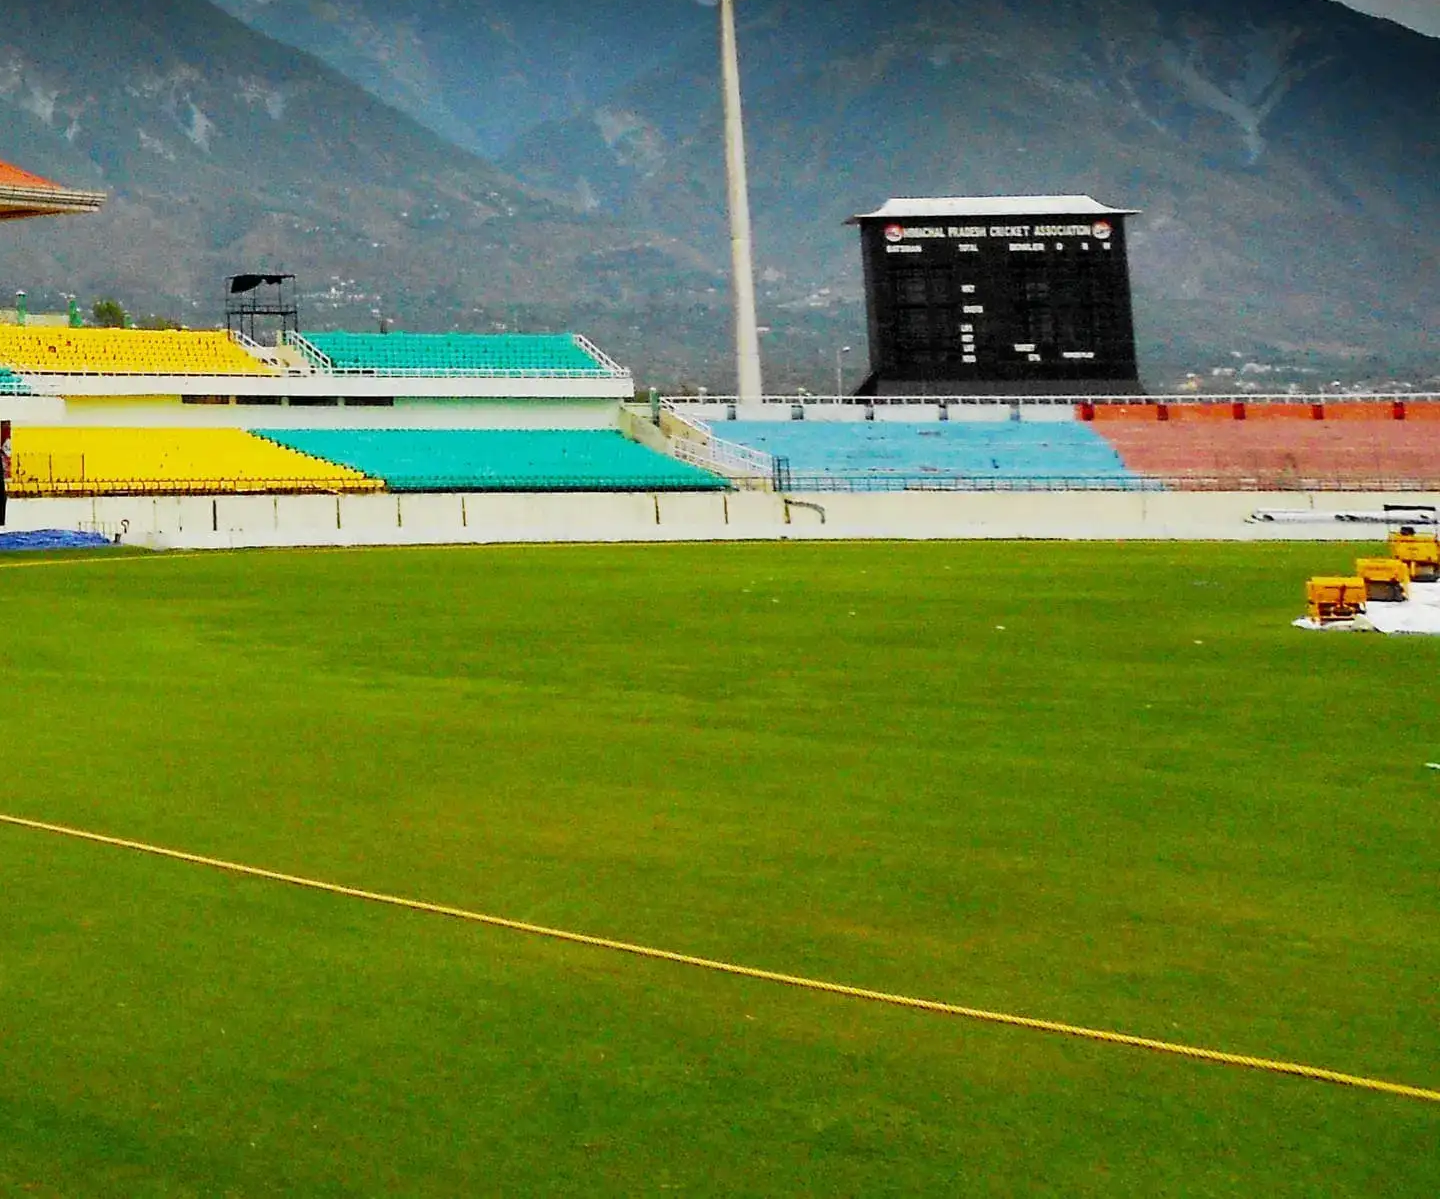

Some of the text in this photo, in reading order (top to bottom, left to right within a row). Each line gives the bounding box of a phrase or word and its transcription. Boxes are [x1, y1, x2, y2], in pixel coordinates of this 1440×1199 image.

[947, 226, 987, 237] PRADESH
[990, 226, 1030, 237] CRICKET
[1034, 225, 1091, 236] ASSOCIATION
